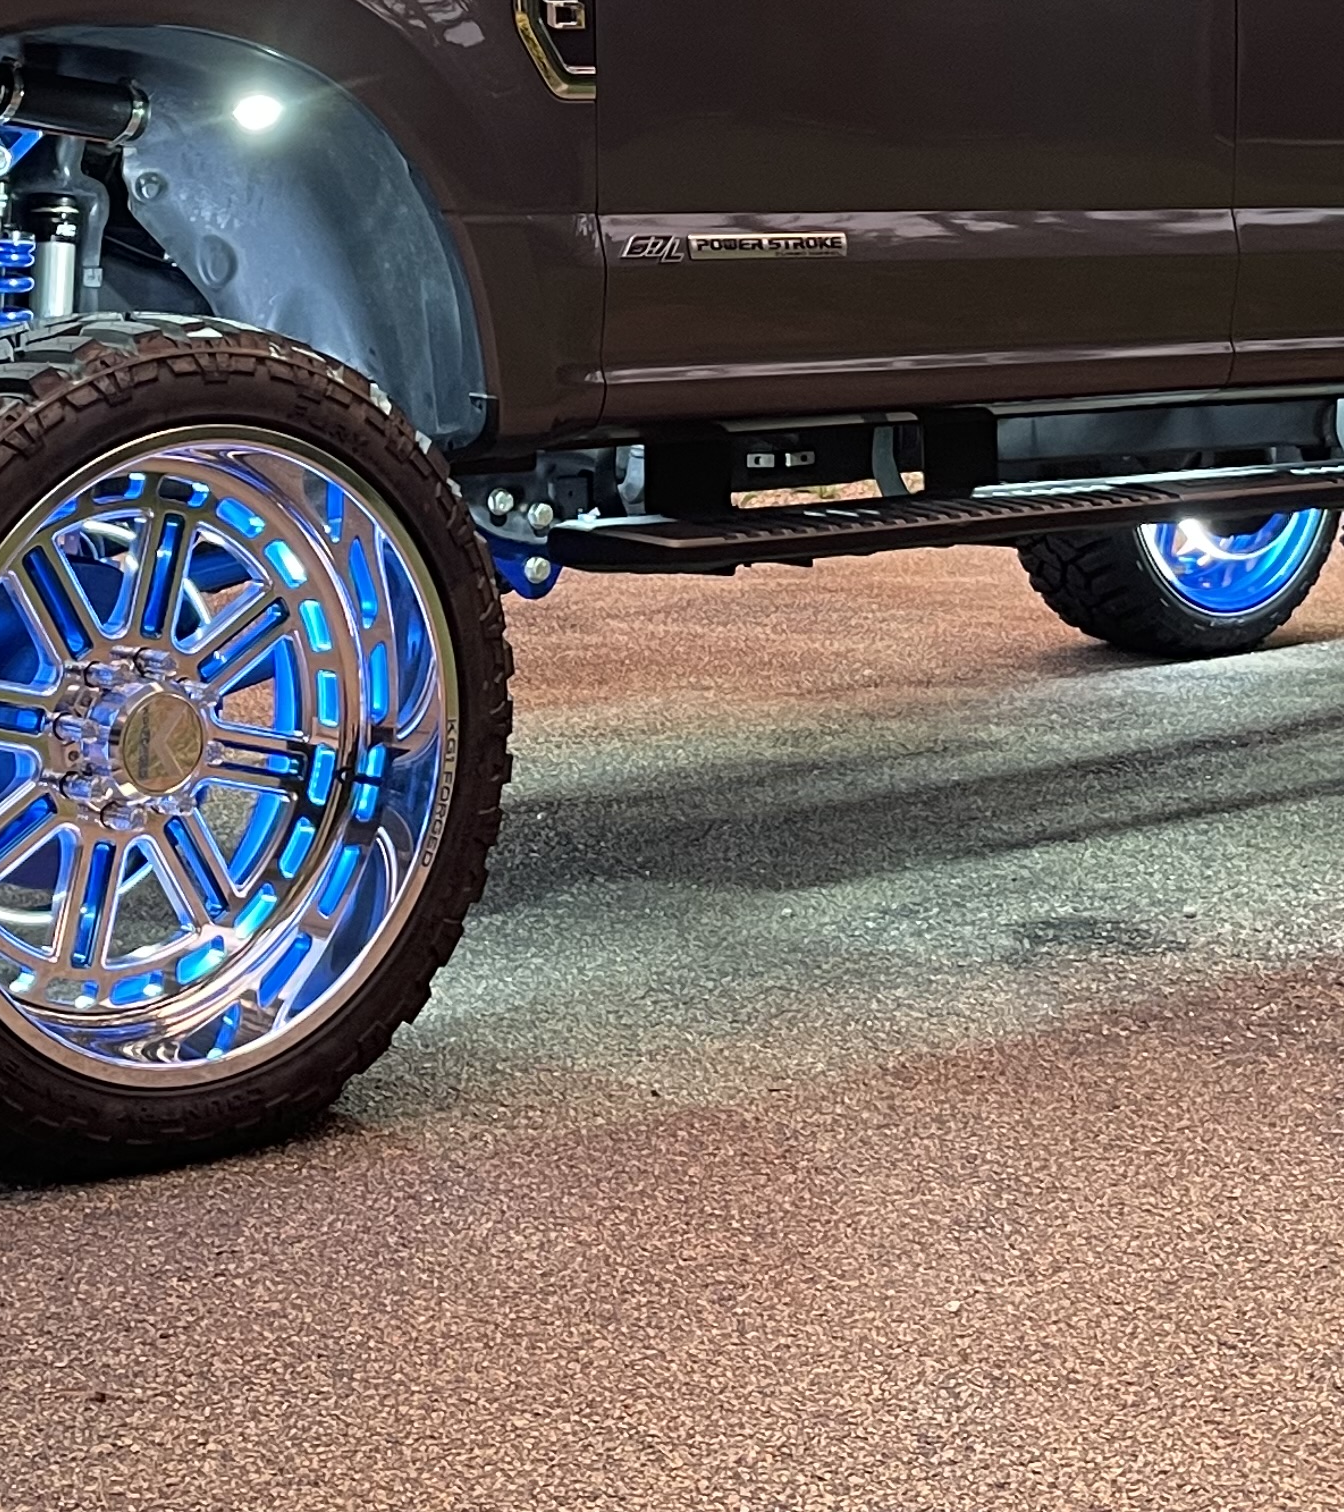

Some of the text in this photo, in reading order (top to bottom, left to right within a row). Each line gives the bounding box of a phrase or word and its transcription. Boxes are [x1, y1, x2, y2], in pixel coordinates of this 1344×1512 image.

[619, 234, 685, 263] 6.7L
[696, 236, 843, 251] POWER STROKE
[421, 719, 457, 868] KG1 FORGED
